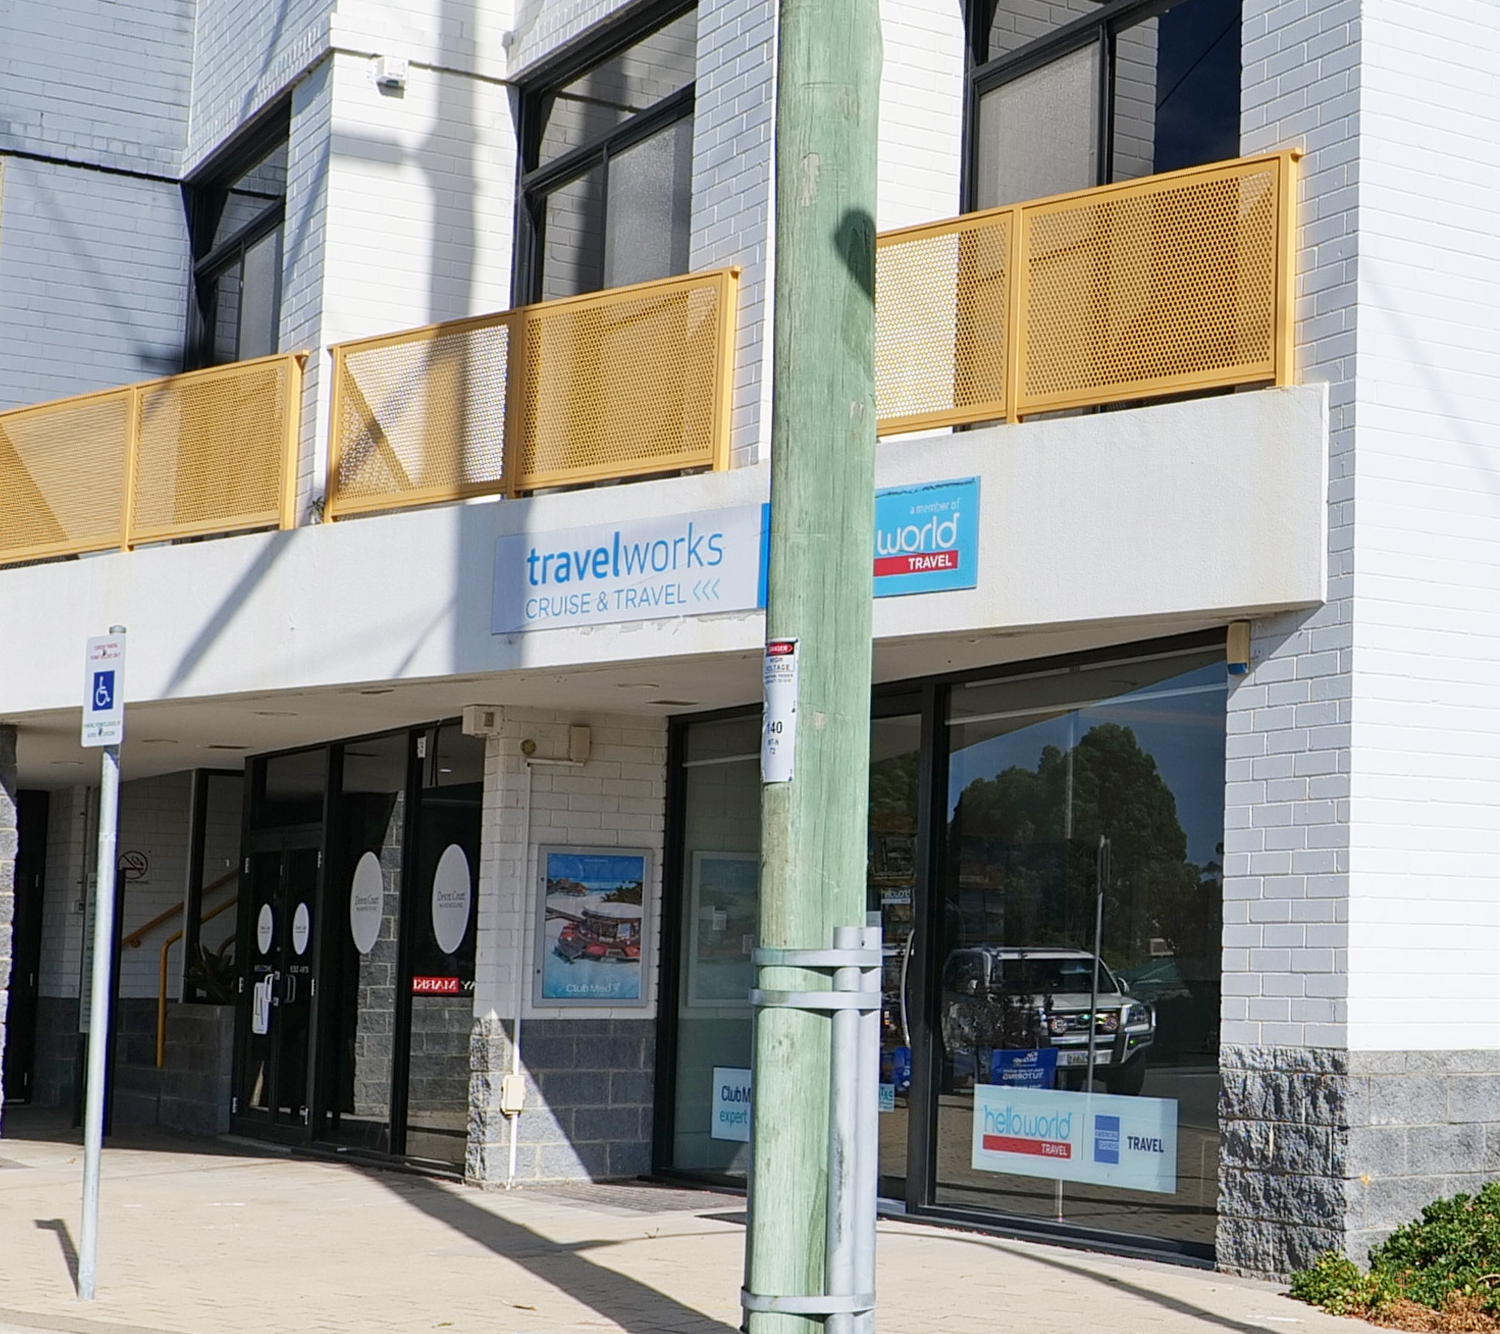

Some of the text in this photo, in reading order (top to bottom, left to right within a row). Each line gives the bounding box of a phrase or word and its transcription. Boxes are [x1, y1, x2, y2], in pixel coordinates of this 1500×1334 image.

[916, 501, 950, 514] member
[526, 522, 723, 586] travelworks
[908, 554, 952, 571] TRAVEL
[525, 583, 687, 619] CRUISE & TRAVEL
[566, 983, 612, 993] Club Med
[720, 1109, 748, 1127] expert
[983, 1104, 1073, 1141] helloworld
[1041, 1143, 1068, 1157] TRAVEL
[1127, 1135, 1164, 1153] TRAVEL
